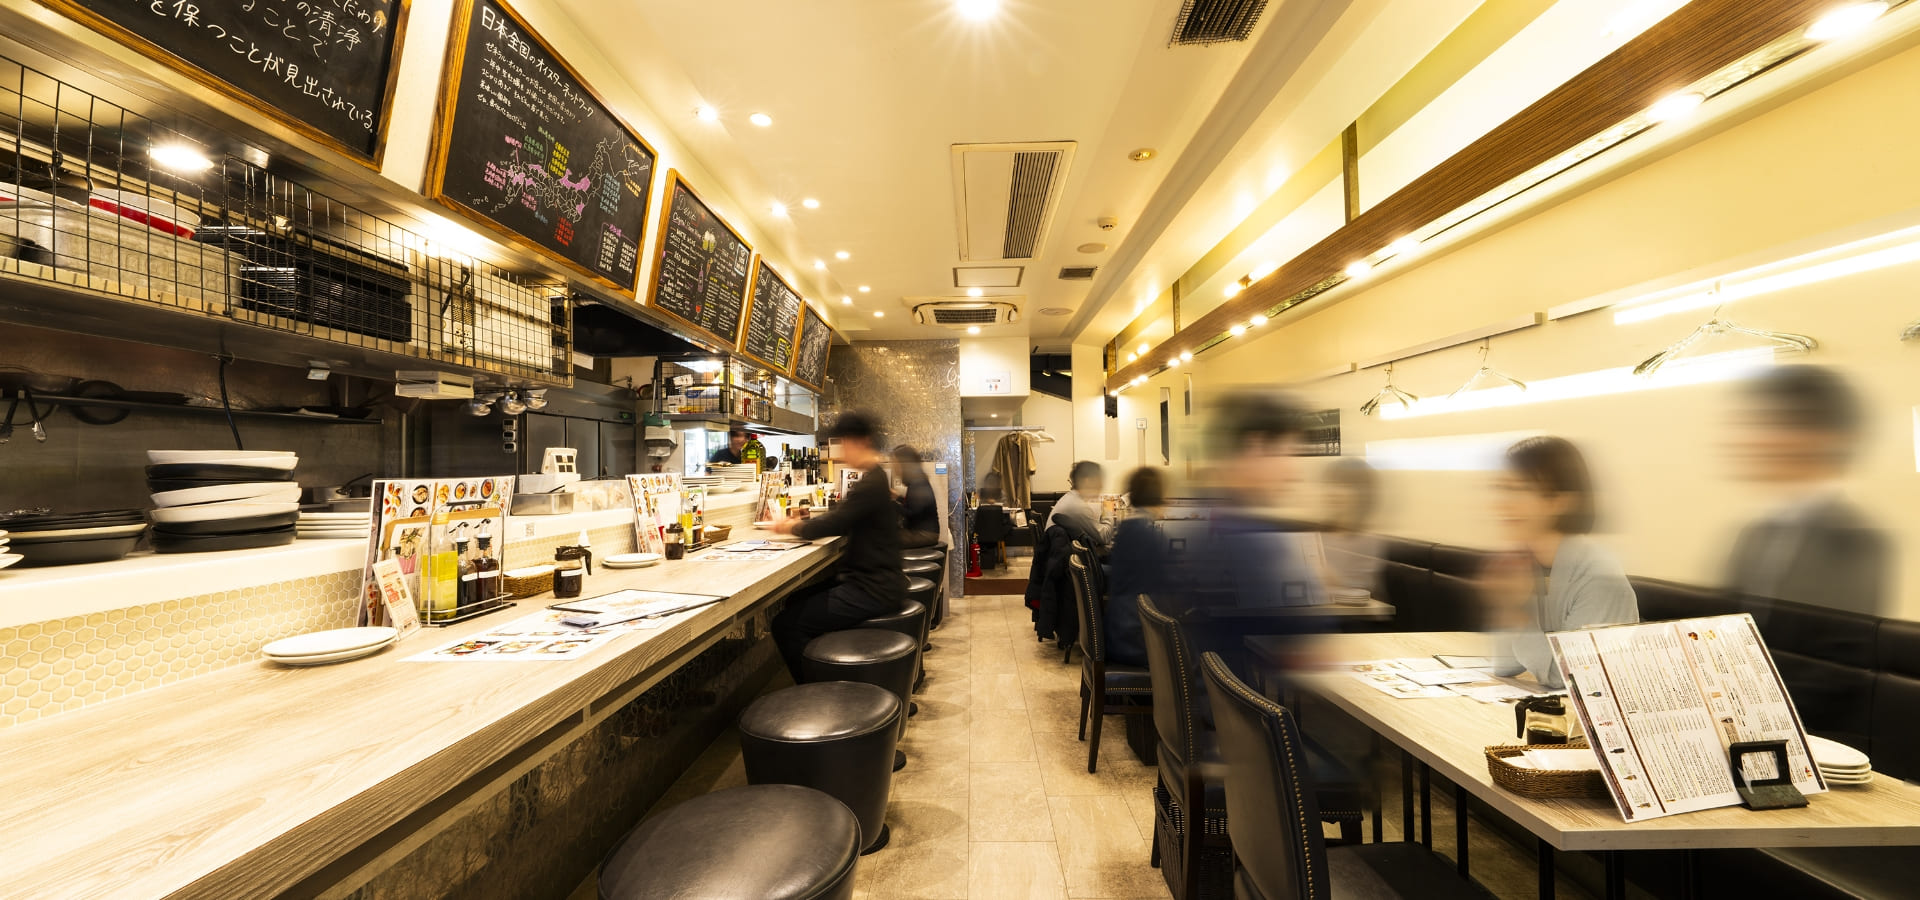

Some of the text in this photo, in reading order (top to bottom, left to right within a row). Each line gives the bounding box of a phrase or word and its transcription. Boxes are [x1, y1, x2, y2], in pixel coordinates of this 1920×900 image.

[482, 5, 594, 118] 日本全国のオイスターネットワーク
